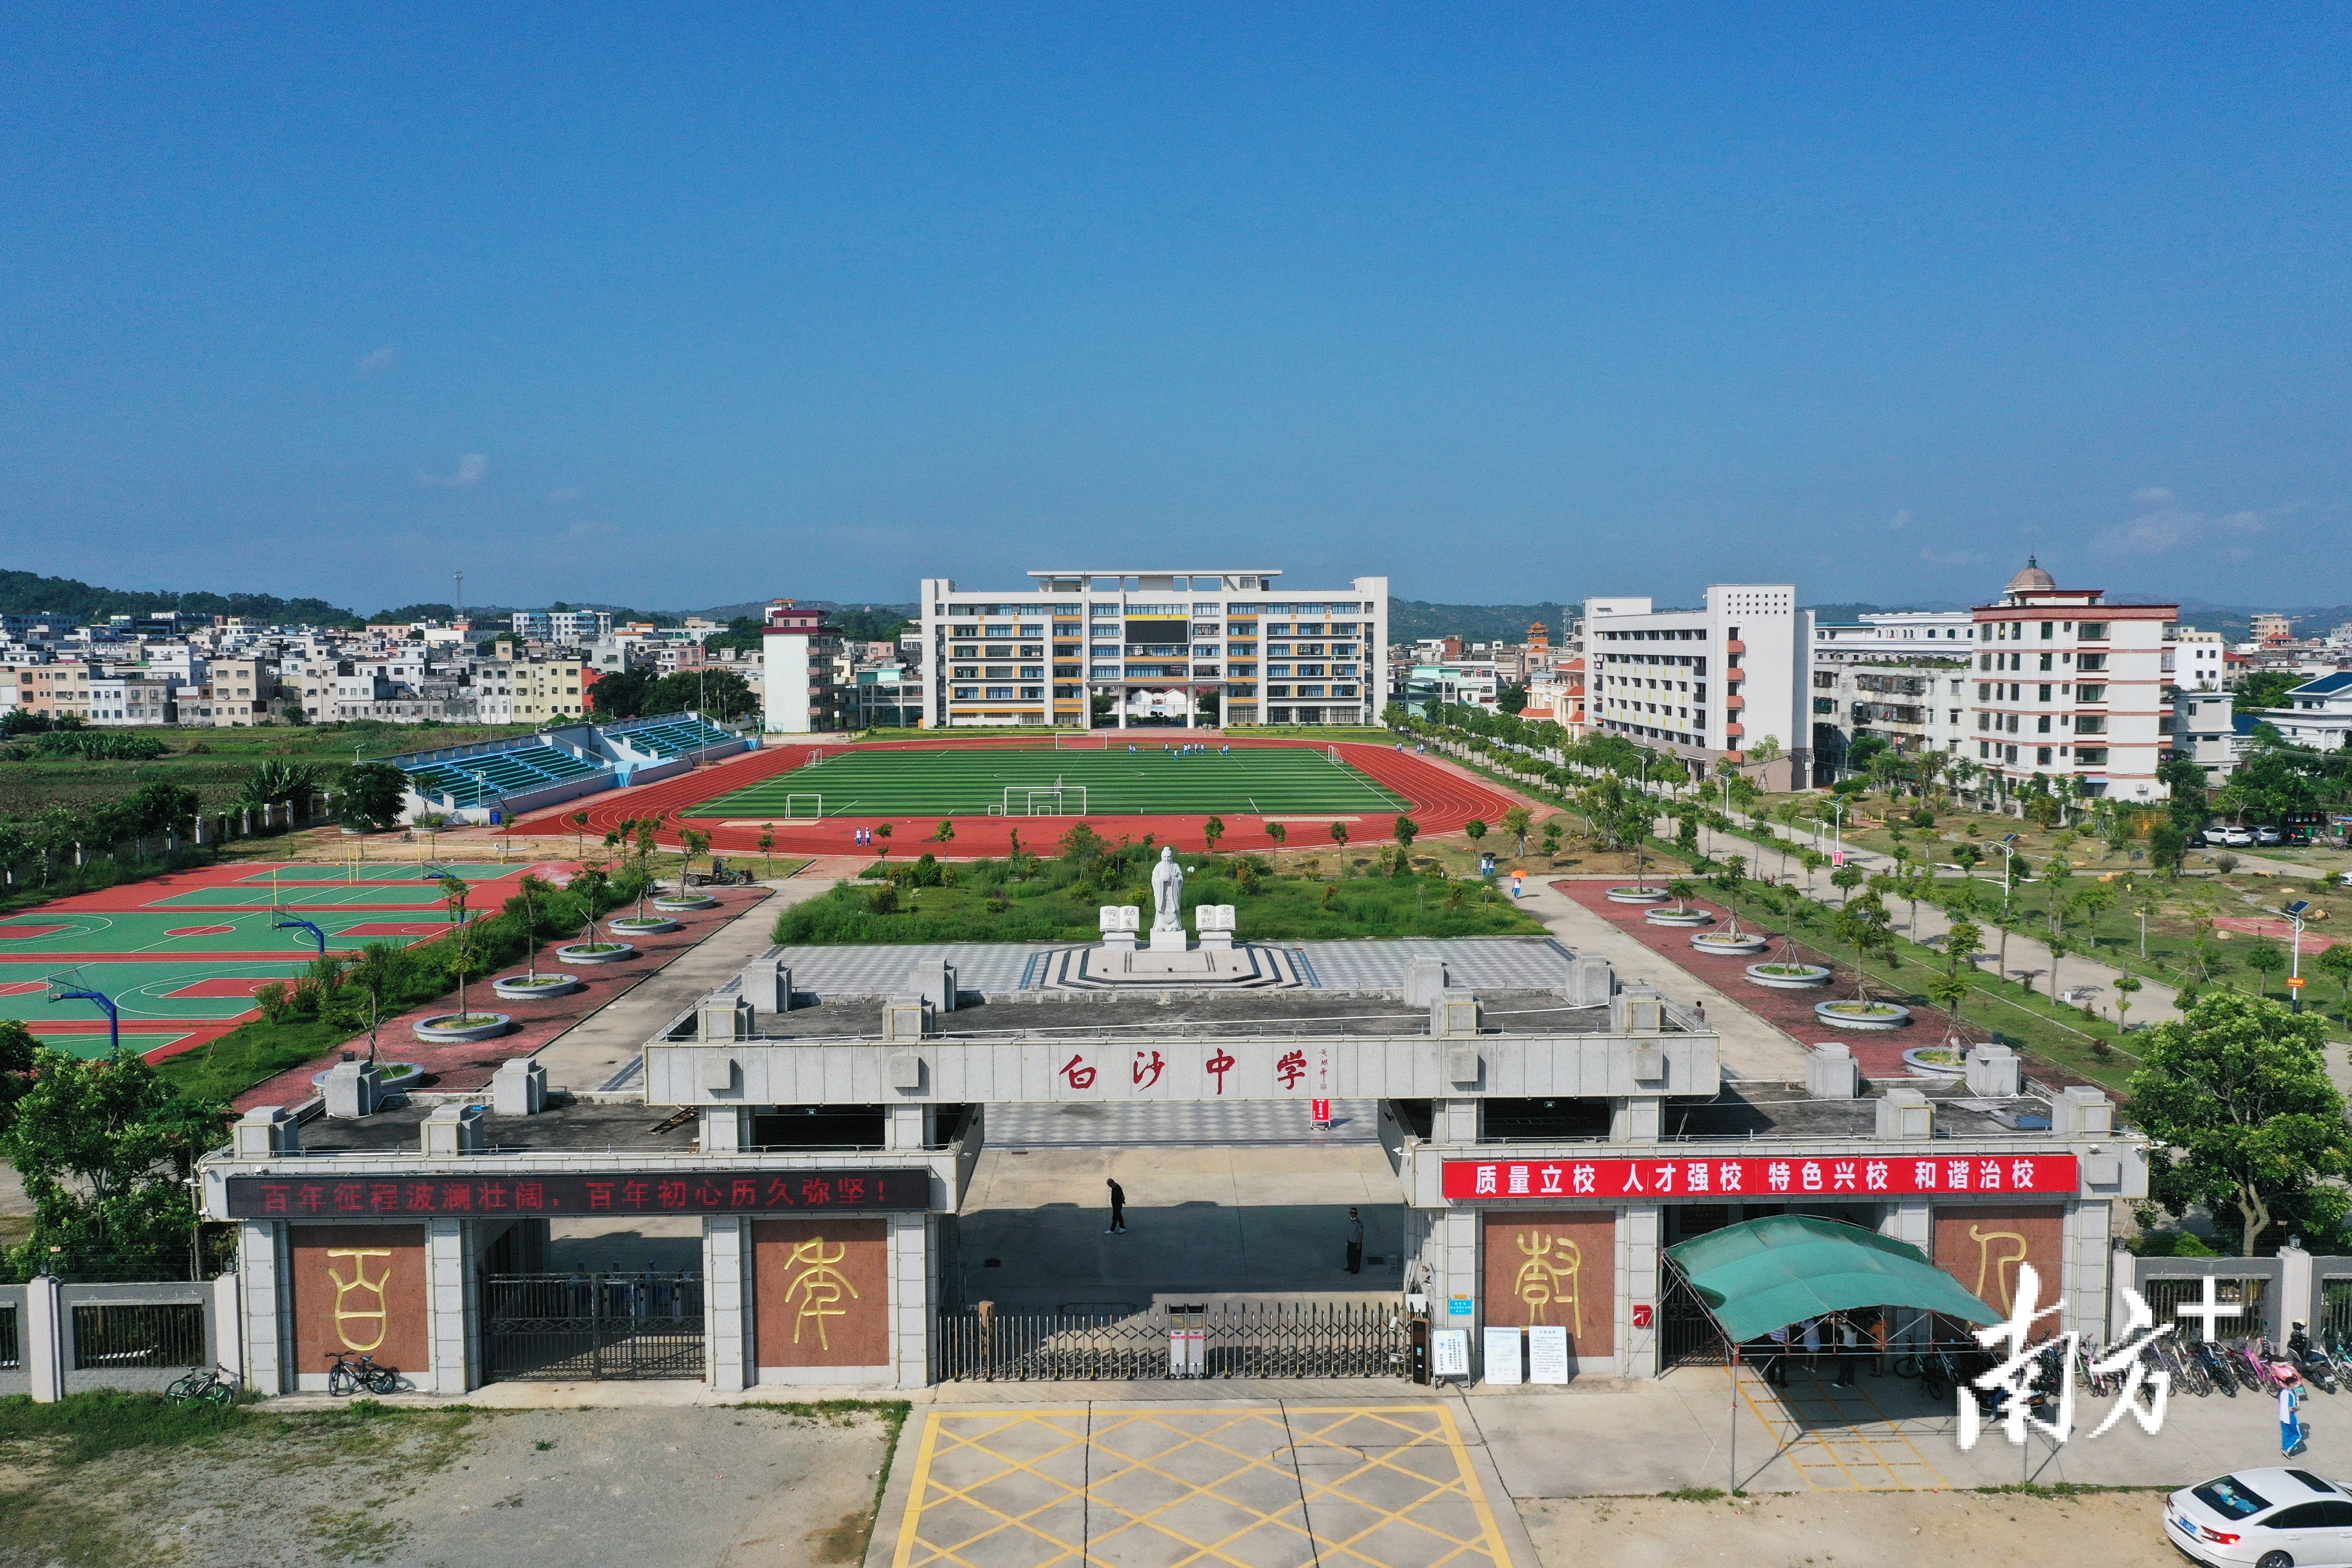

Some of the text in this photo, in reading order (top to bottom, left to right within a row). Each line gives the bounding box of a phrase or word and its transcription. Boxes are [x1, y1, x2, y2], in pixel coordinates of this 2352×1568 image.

[1060, 1048, 1307, 1095] 白沙中学
[1475, 1159, 2034, 1194] 质量立校 人才强校 特色兴校 和谐治校
